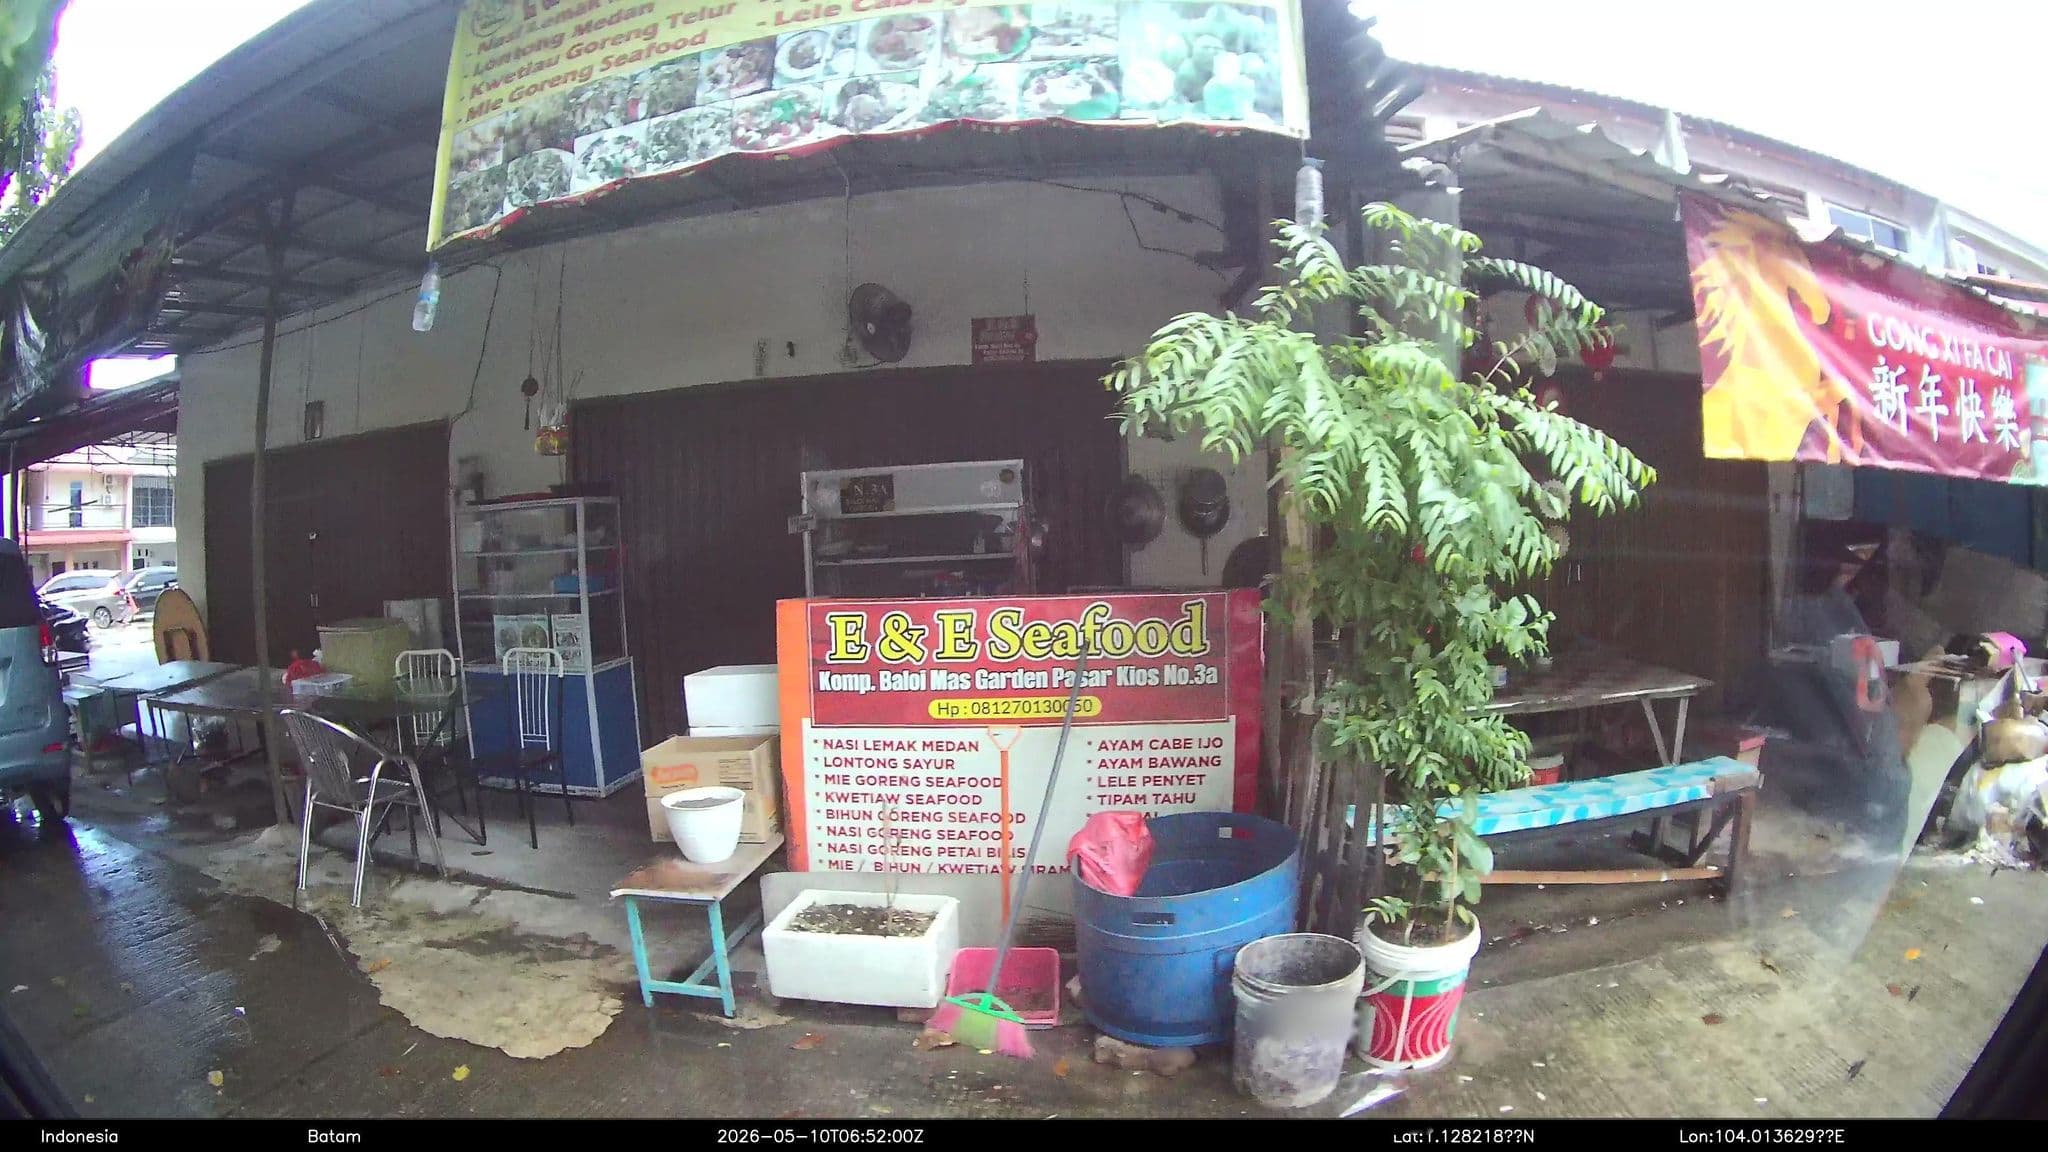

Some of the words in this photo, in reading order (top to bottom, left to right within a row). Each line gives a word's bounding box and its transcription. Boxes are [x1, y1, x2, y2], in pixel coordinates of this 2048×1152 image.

[774, 2, 842, 26] Lele
[473, 32, 566, 76] Lontong
[572, 2, 655, 38] Medan
[470, 54, 561, 98] Kwetiau
[565, 22, 659, 60] Goreng
[667, 2, 737, 28] Telur
[466, 98, 503, 123] Mie
[508, 64, 595, 102] Goreng
[600, 29, 709, 72] Seafood
[1942, 335, 1961, 366] XI
[1963, 338, 1985, 371] FA
[1986, 346, 2013, 380] CAI
[1868, 354, 2020, 454] 新年快樂
[827, 613, 869, 662] E
[877, 612, 927, 664] &
[935, 611, 979, 661] E
[989, 599, 1208, 660] Seafood
[819, 671, 876, 694] Komp.
[880, 670, 927, 691] Baloi
[931, 669, 972, 690] Mas
[975, 667, 1049, 689] Garden
[1052, 666, 1113, 688] Pasar
[1116, 664, 1160, 686] Kios
[1163, 663, 1218, 685] No.3a
[823, 739, 858, 751] NASI
[863, 740, 917, 752] LEMAK
[922, 741, 979, 752] MEDAN
[1098, 740, 1144, 752] AYAM
[1149, 738, 1193, 750] CABE
[1198, 737, 1223, 749] IJO
[823, 757, 898, 769] LONTONG
[903, 758, 955, 770] SAYUR
[1098, 758, 1143, 770] AYAM
[1148, 756, 1222, 769] BAWANG
[824, 774, 851, 786] MIE
[855, 775, 921, 787] GORENG
[925, 776, 1003, 788] SEAFOOD
[1098, 776, 1136, 787] LELE
[1142, 774, 1206, 787] PENYET
[825, 792, 900, 804] KWETIAW
[905, 794, 982, 805] SEAFOOD
[1097, 794, 1147, 805] TIPAM
[1152, 793, 1196, 805] TAHU
[826, 809, 873, 821] BIHUN
[827, 826, 862, 838] NASI
[827, 843, 862, 855] NASI
[867, 844, 932, 857] GORENG
[937, 846, 981, 858] PETAI
[987, 847, 1026, 859] BIIS
[828, 859, 854, 871] MIE
[874, 861, 920, 873] BHUN
